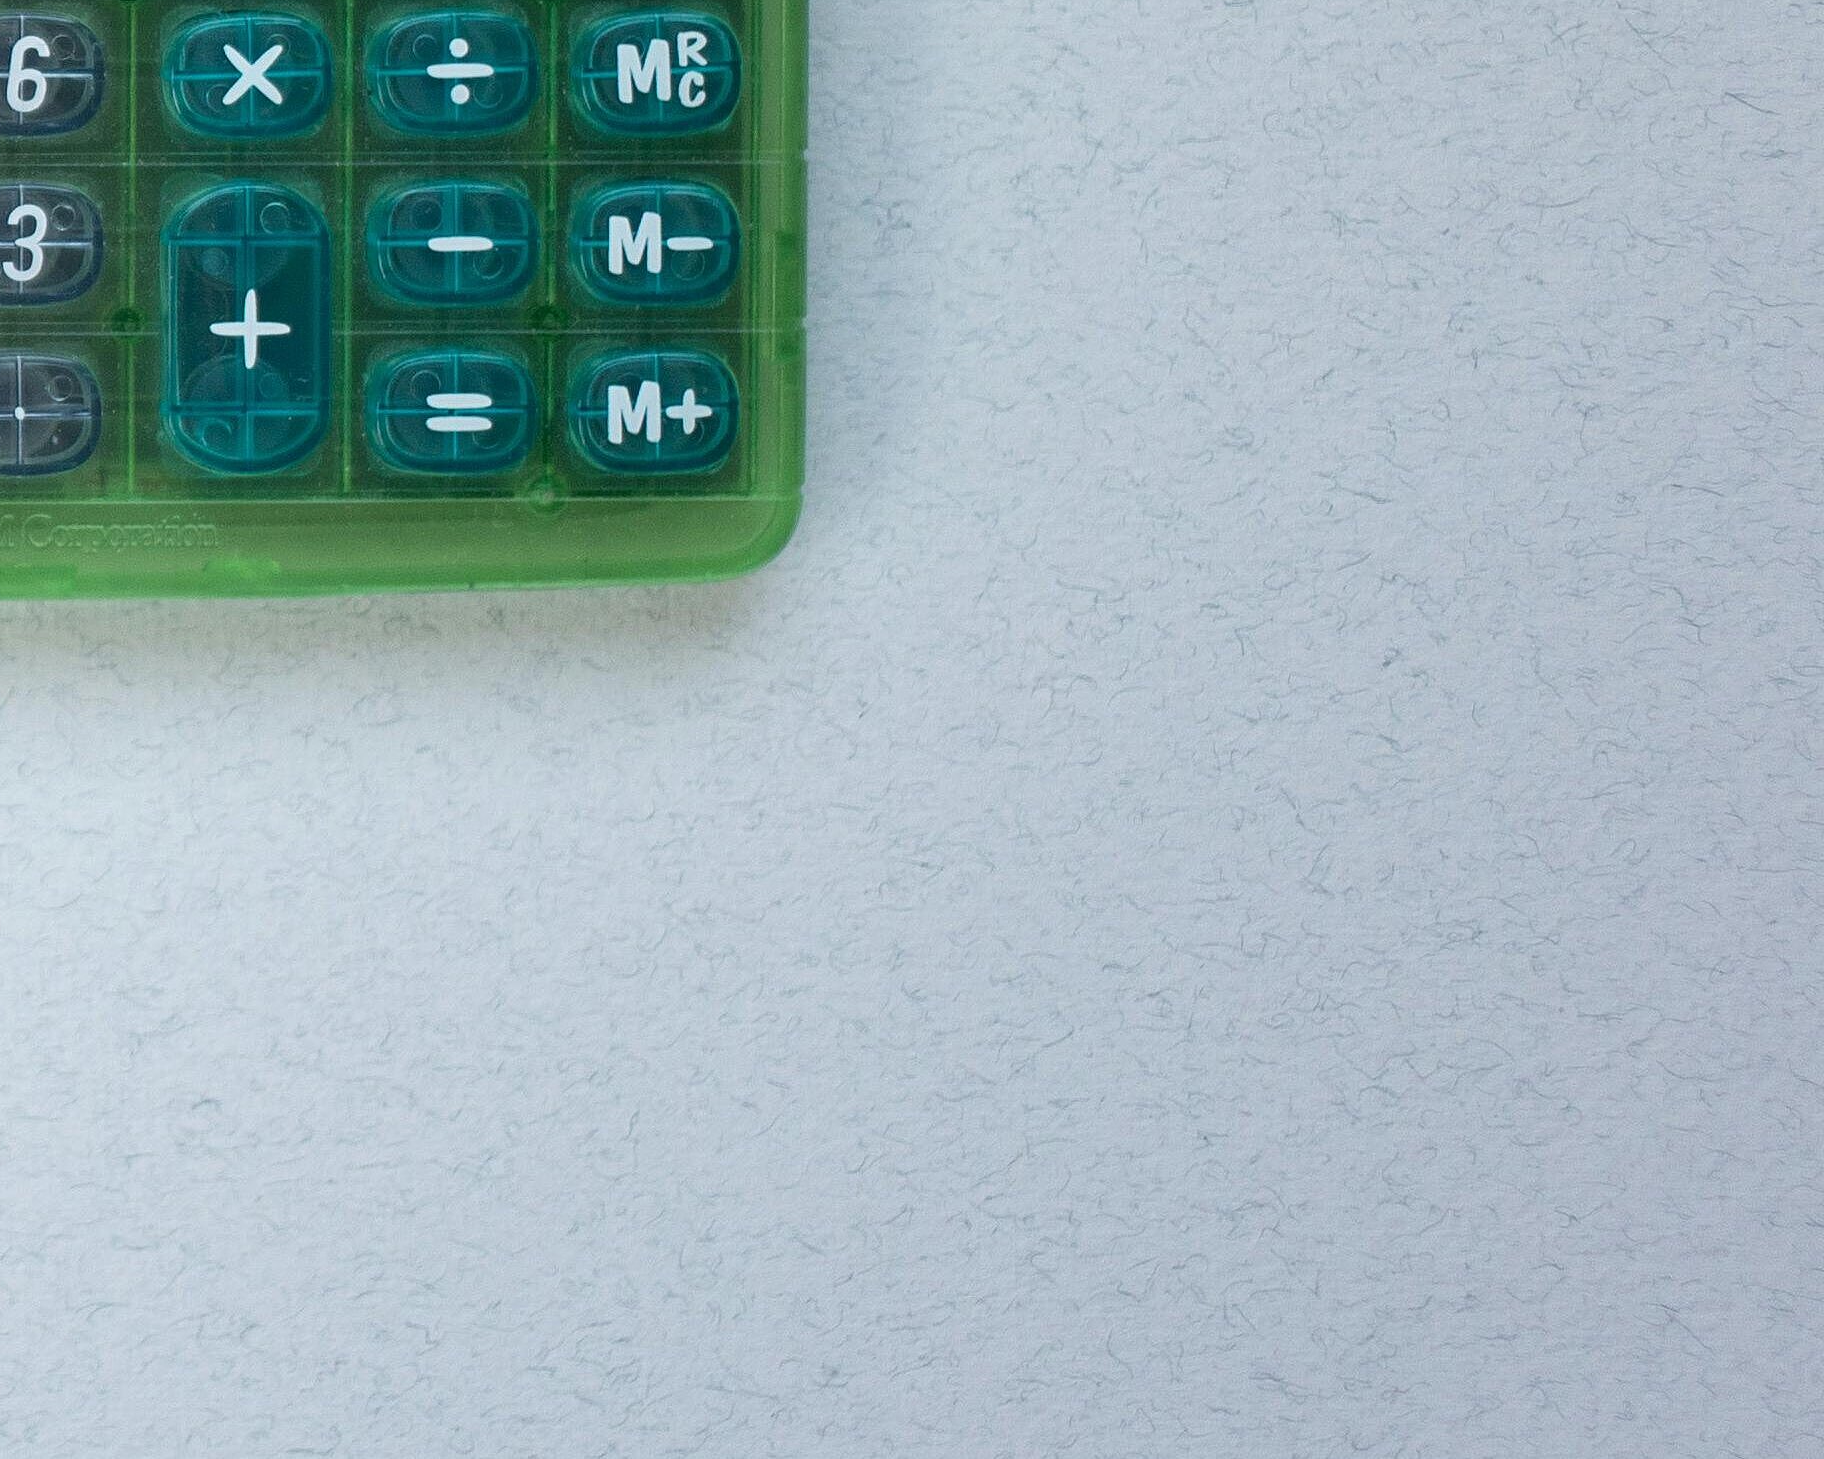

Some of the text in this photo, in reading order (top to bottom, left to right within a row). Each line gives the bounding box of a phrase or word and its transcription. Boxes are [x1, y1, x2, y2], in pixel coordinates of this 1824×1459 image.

[5, 34, 49, 114] 6
[1, 203, 51, 283] 3
[607, 380, 713, 445] M+
[21, 513, 219, 554] Corporation
